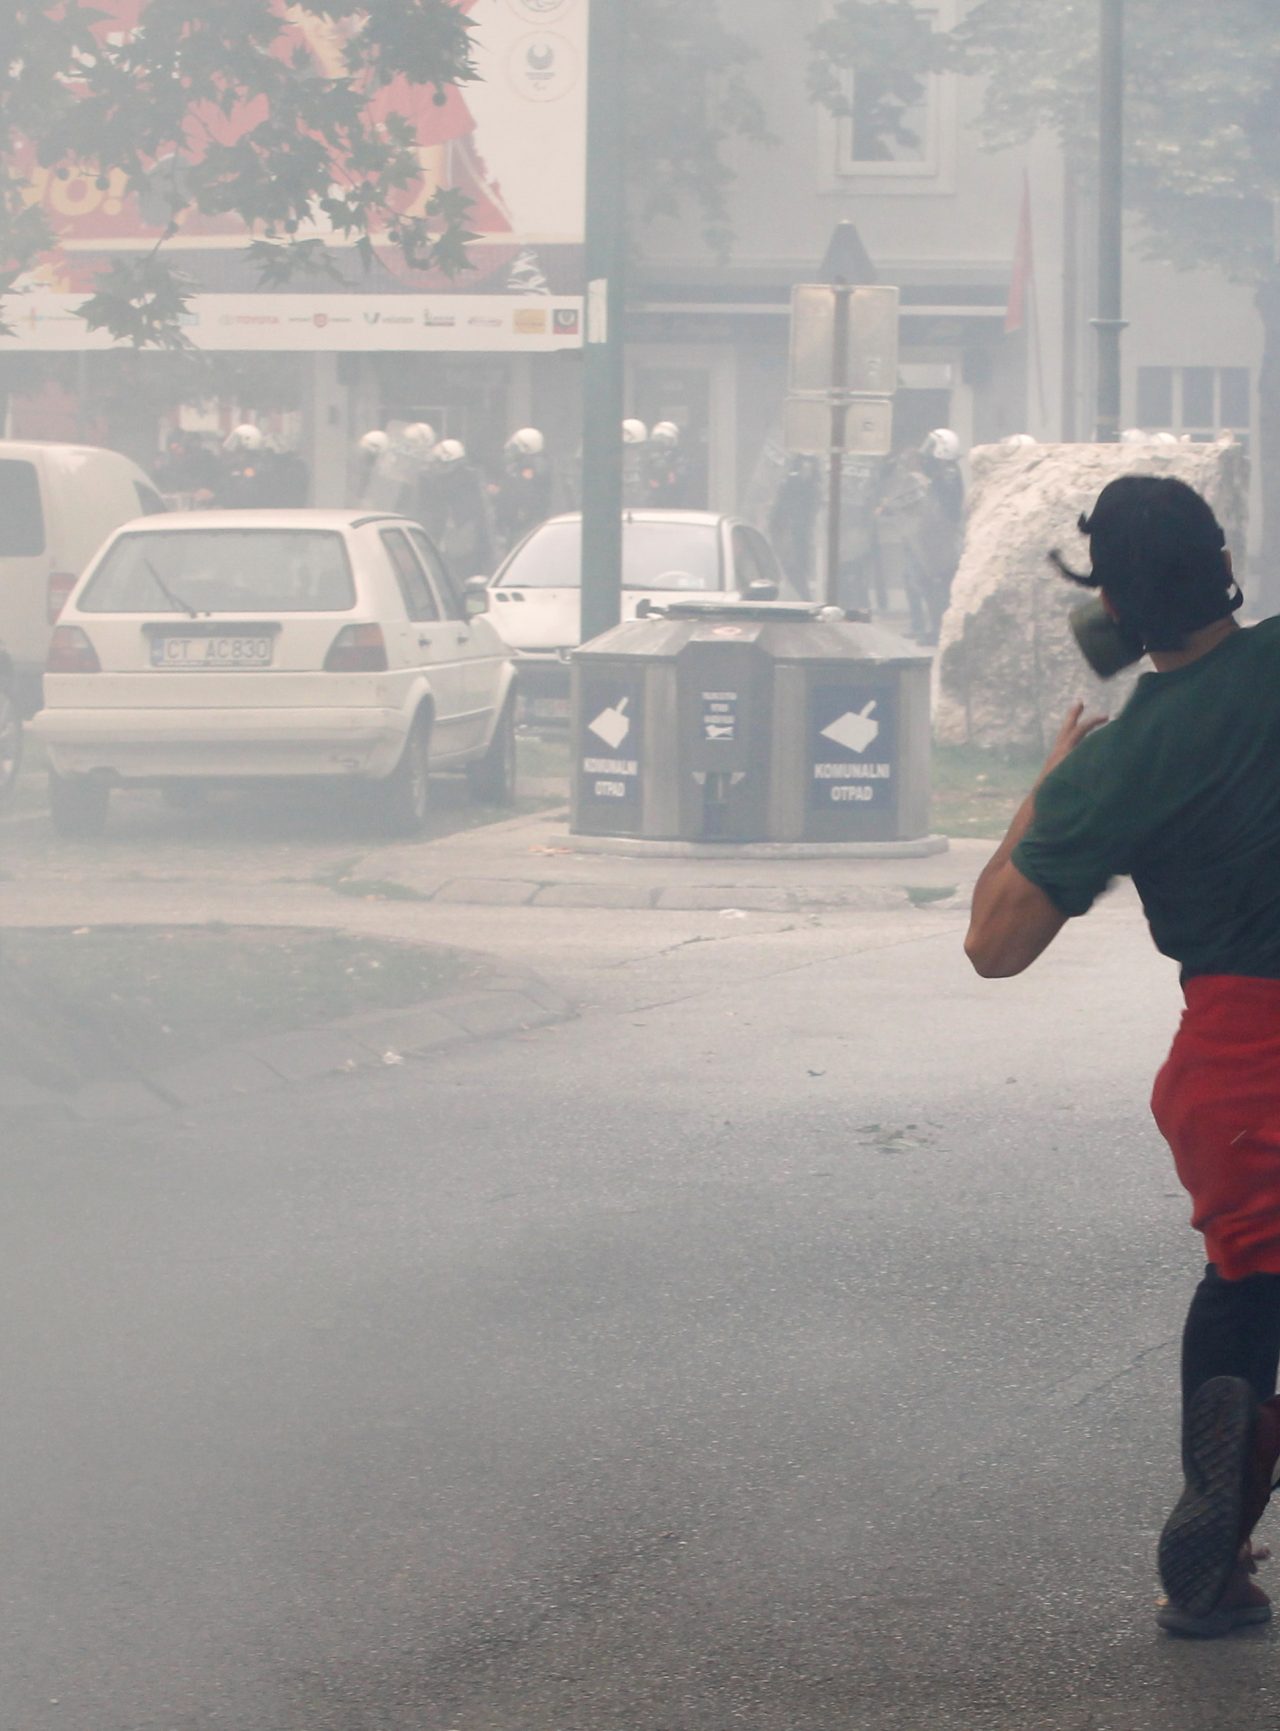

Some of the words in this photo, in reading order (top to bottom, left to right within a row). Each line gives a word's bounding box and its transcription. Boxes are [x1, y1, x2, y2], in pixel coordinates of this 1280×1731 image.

[167, 639, 191, 659] CT
[814, 763, 890, 779] KOMUNALNI
[595, 781, 625, 797] OTPAD
[831, 786, 873, 801] OTPAD
